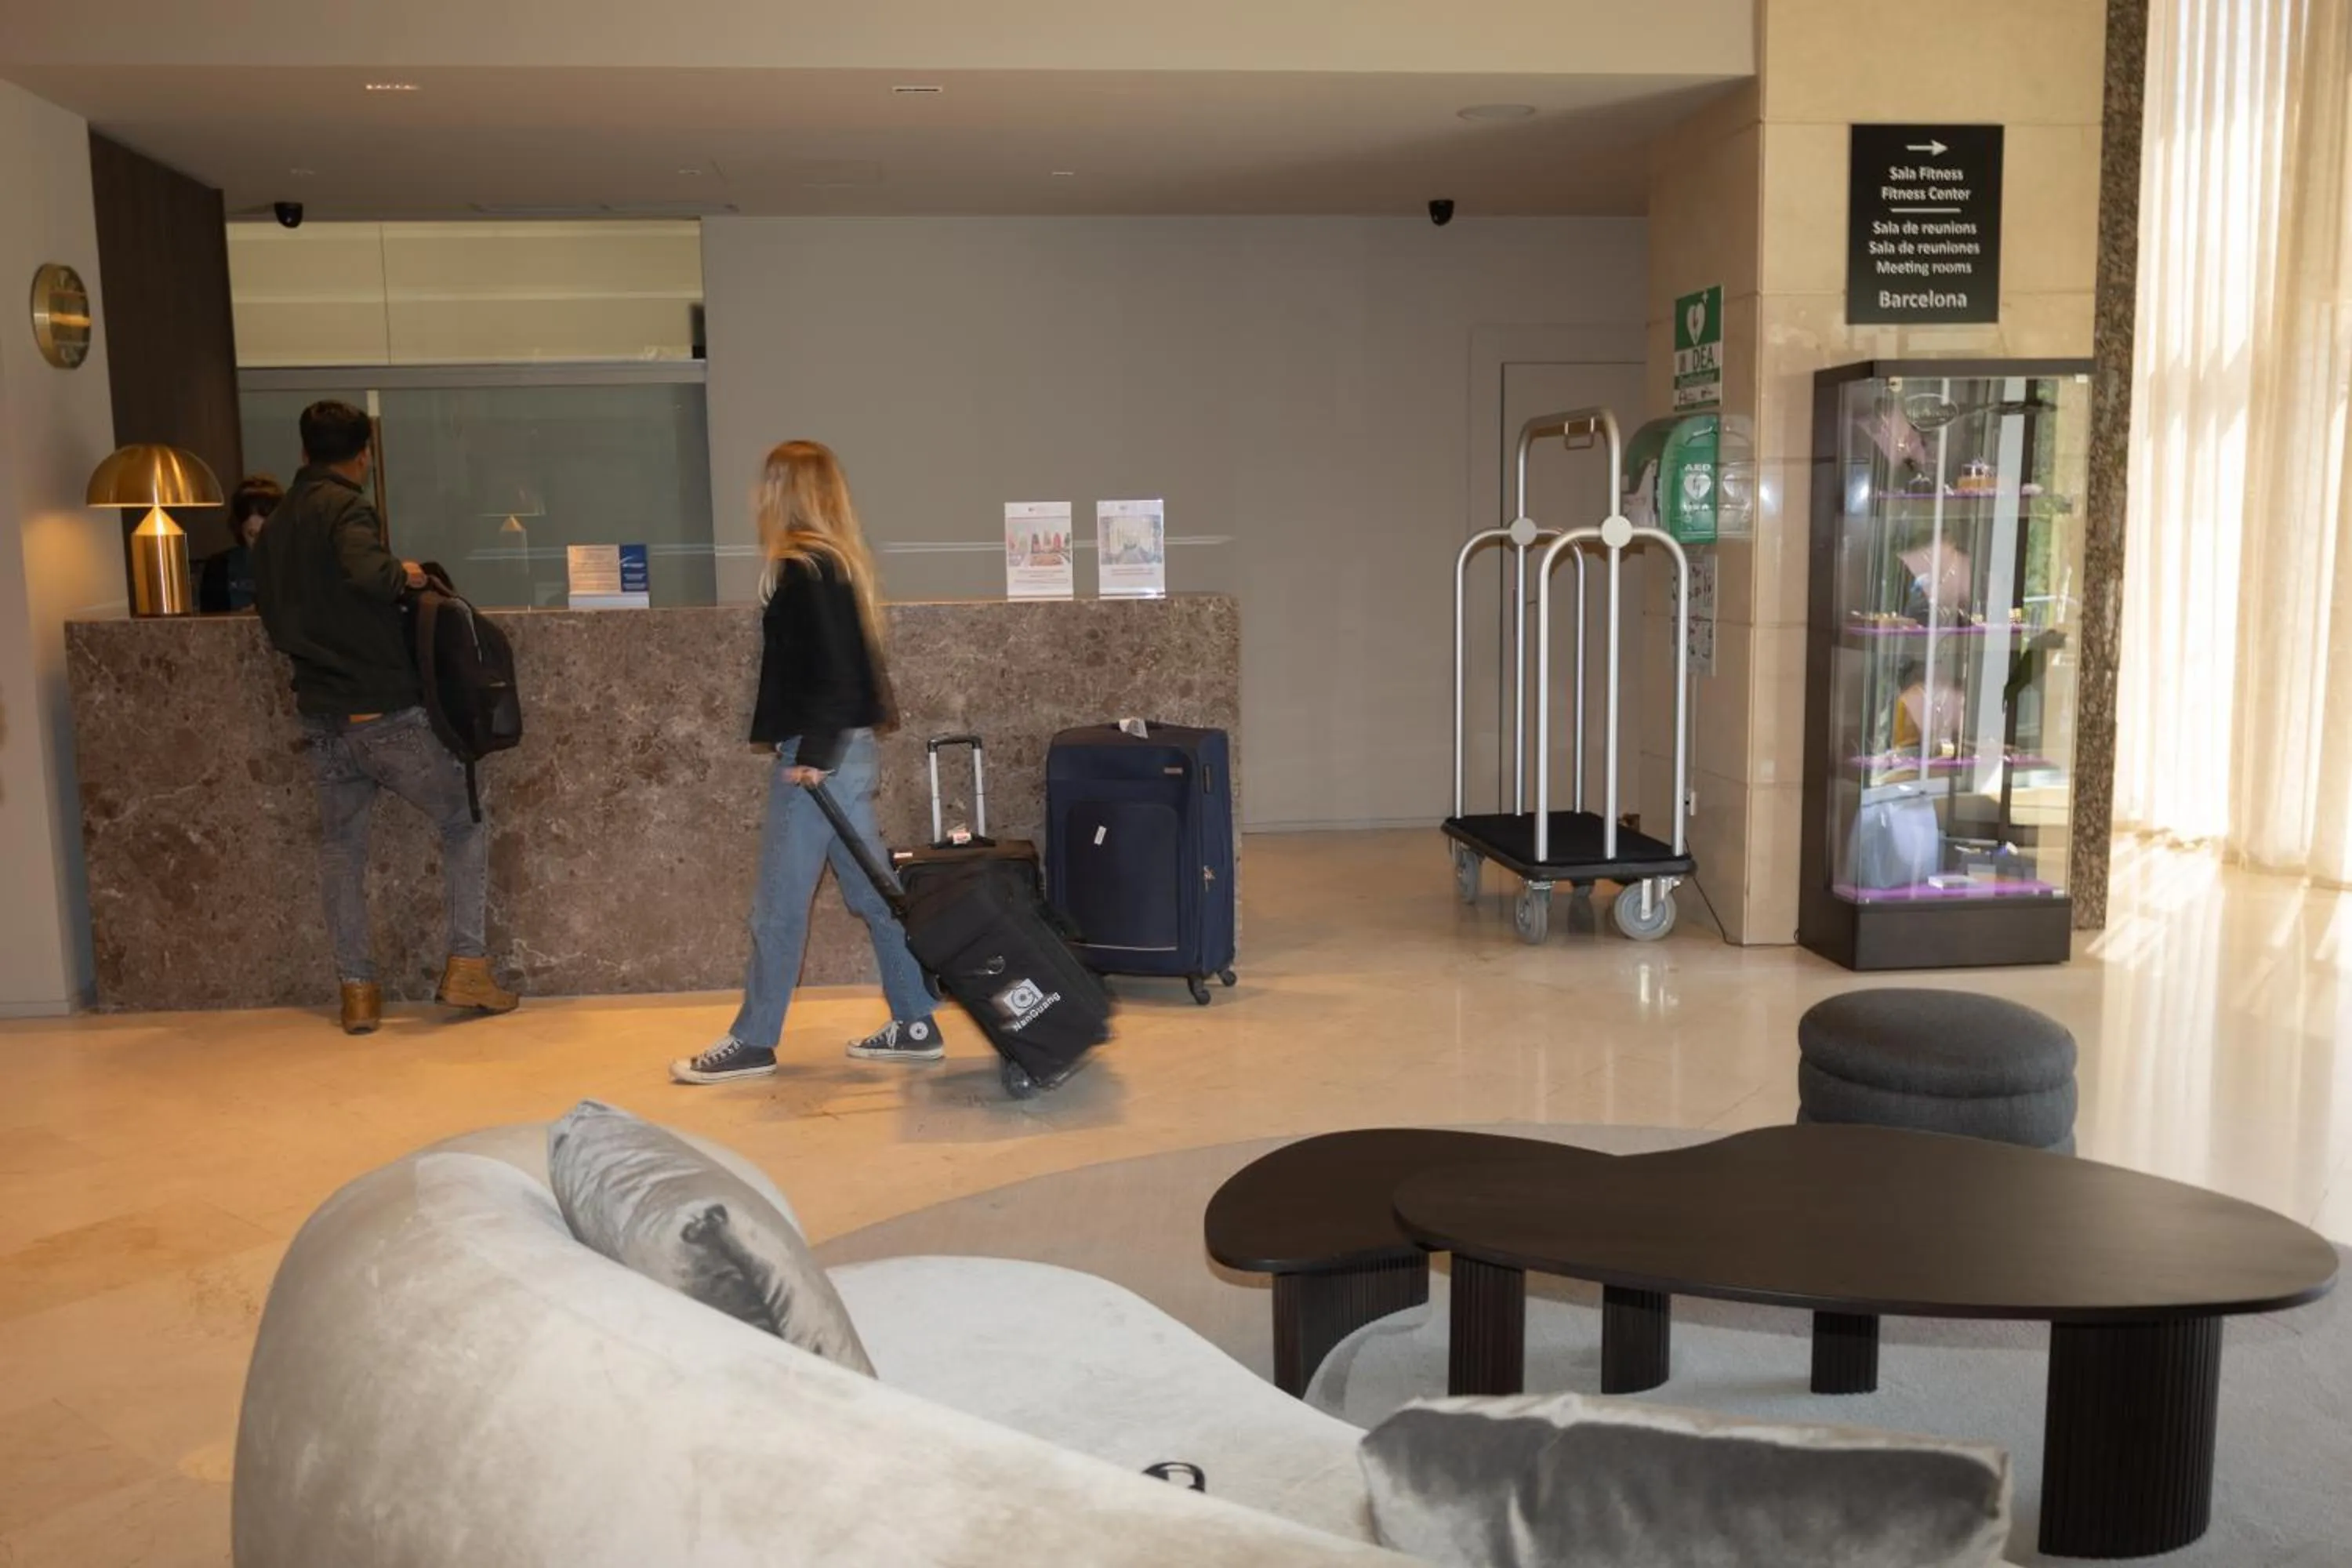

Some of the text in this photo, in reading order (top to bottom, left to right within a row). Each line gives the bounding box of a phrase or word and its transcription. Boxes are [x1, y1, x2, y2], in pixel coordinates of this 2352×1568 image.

[1889, 165, 1963, 180] Sala Fitness
[1881, 186, 1971, 201] Fitness Center
[1872, 220, 1977, 234] Sala de reunions
[1868, 240, 1980, 254] Sala de reuniones
[1876, 260, 1973, 276] Meeting rooms
[1878, 290, 1967, 308] Barcelona
[1693, 346, 1715, 370] DEA
[1684, 463, 1711, 472] AED
